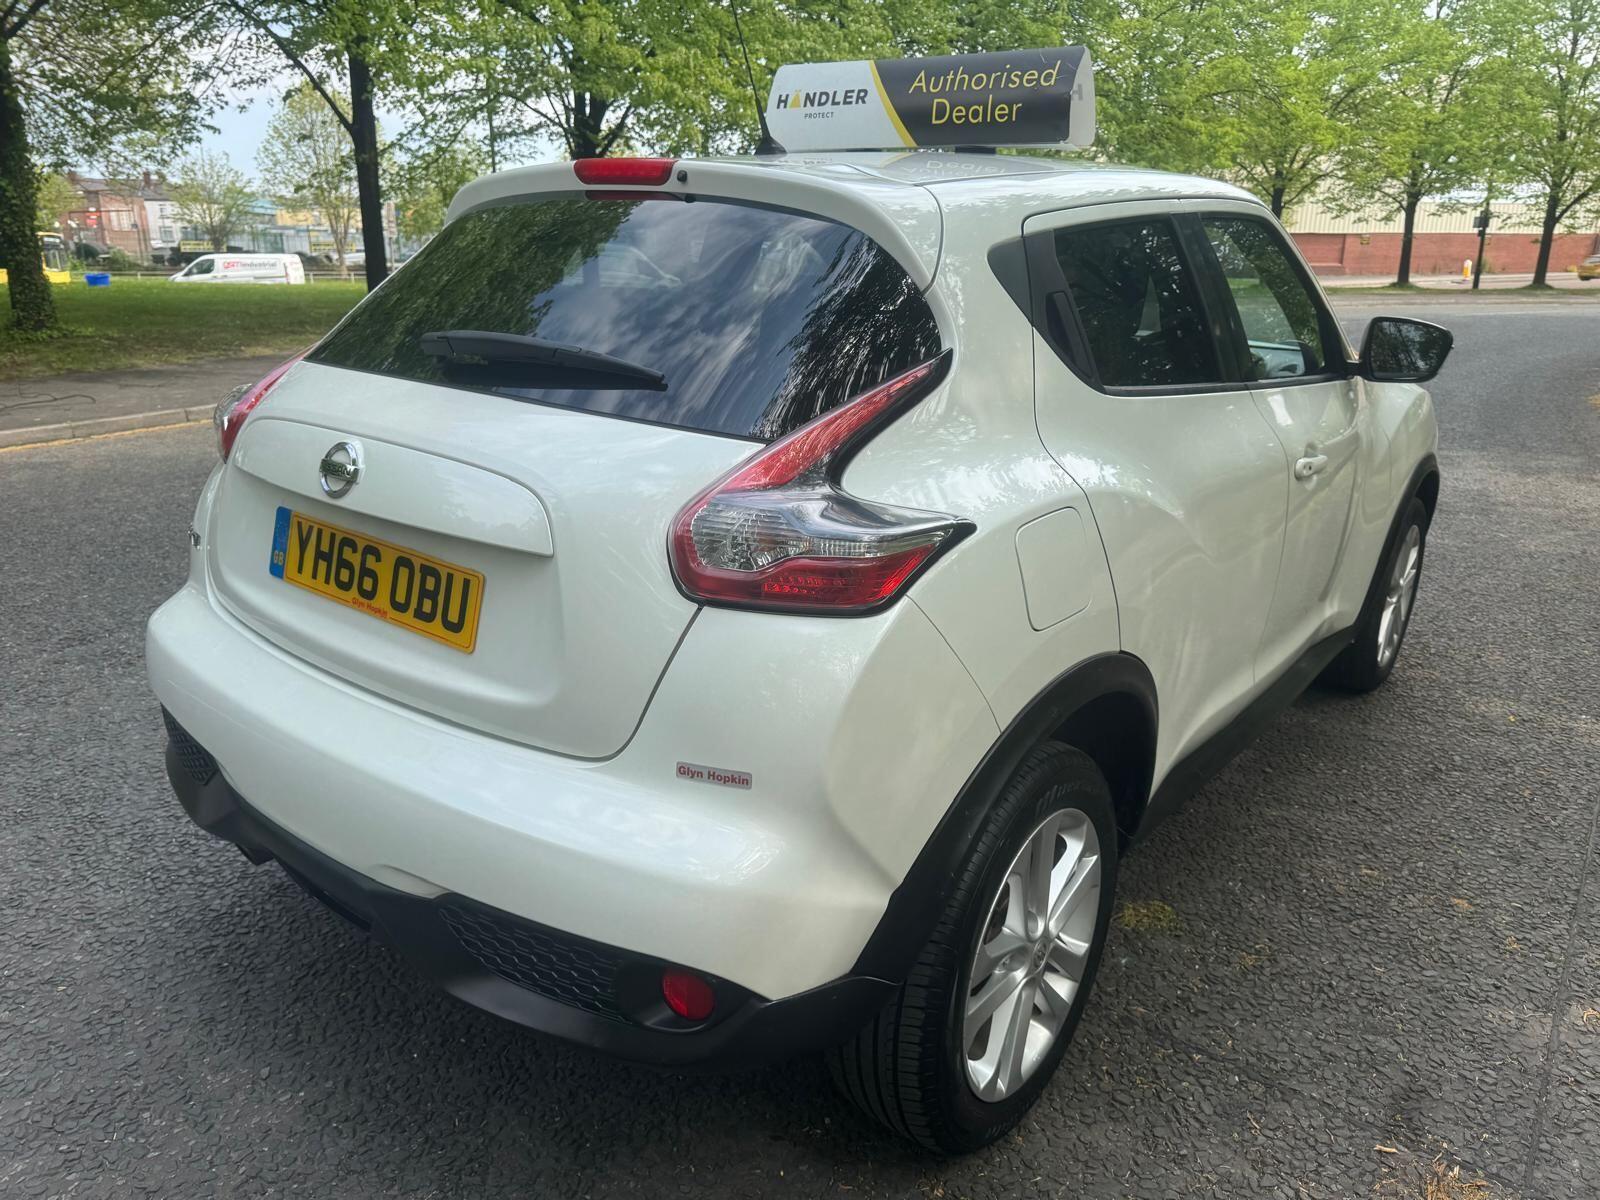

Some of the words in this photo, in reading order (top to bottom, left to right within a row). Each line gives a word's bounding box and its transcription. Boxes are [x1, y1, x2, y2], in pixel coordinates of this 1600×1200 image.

[908, 60, 1061, 94] Authorised
[931, 94, 1022, 125] Dealer
[273, 550, 284, 566] GB
[297, 521, 381, 600] YH66
[390, 556, 470, 633] OBU
[678, 765, 704, 779] Glyn
[707, 769, 749, 786] Hopkin
